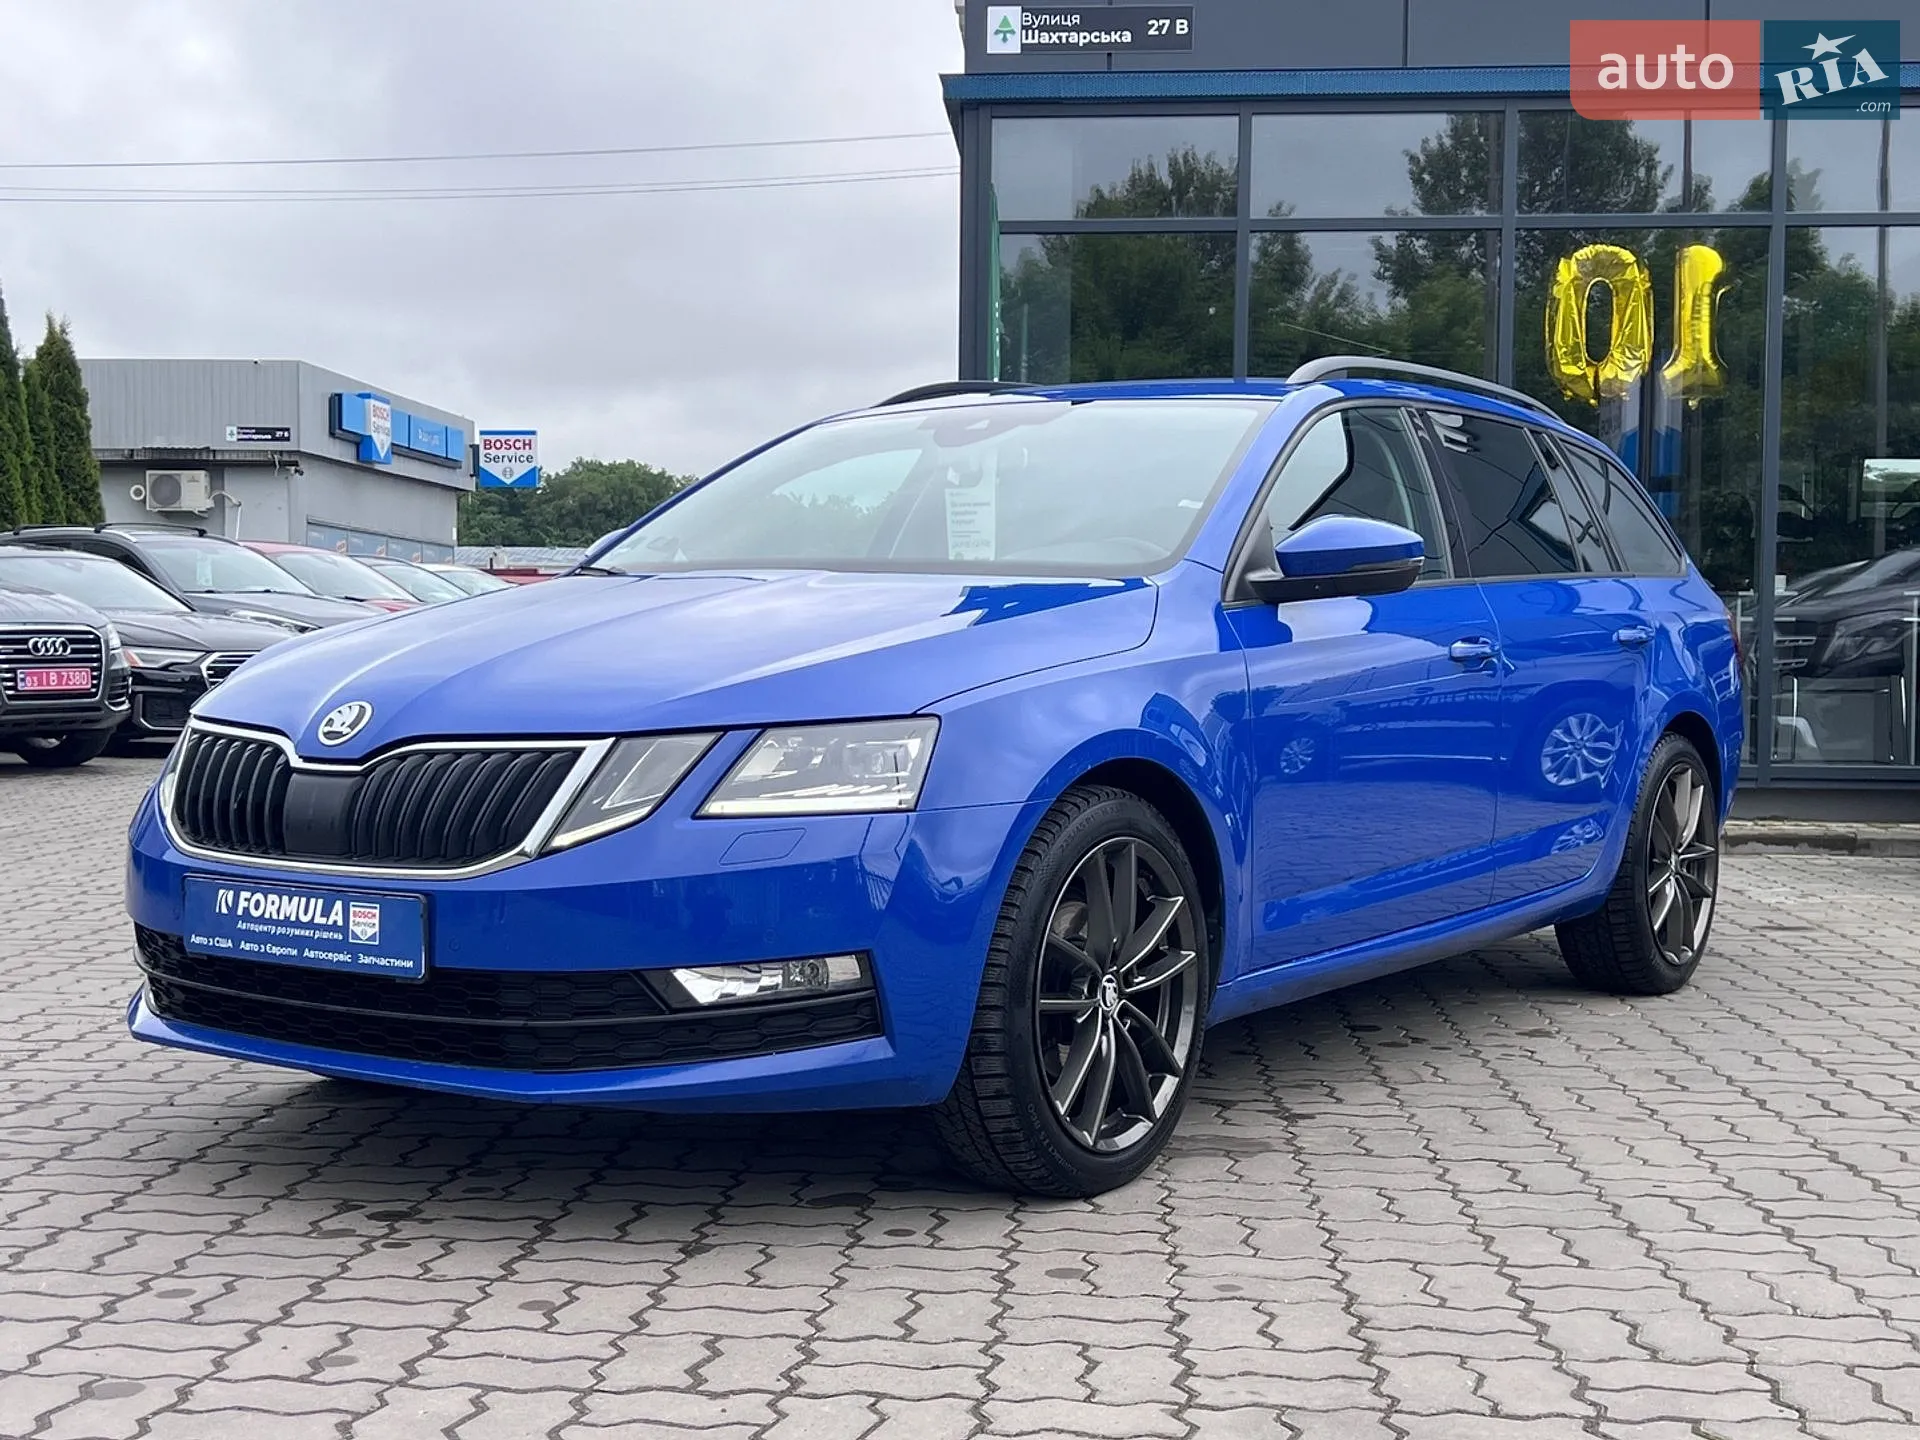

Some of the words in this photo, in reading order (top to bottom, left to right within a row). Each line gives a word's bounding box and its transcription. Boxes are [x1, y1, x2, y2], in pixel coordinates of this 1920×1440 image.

[1022, 12, 1080, 27] Вулиця
[1147, 19, 1170, 36] 27
[1021, 29, 1132, 46] Шахтарська
[482, 438, 532, 451] BOSCH
[483, 452, 534, 464] Service
[25, 676, 38, 687] 03
[61, 671, 87, 685] 7380
[237, 891, 343, 926] FORMULA
[352, 910, 377, 920] BOSCH
[236, 920, 276, 935] Автоцентр
[314, 928, 343, 941] рішень
[352, 919, 377, 929] Service
[190, 934, 207, 946] Авто
[214, 937, 233, 949] США
[239, 940, 259, 953] Авто
[266, 943, 298, 957] Європи
[303, 948, 352, 963] Автосервіс
[357, 953, 414, 969] Запчастини
